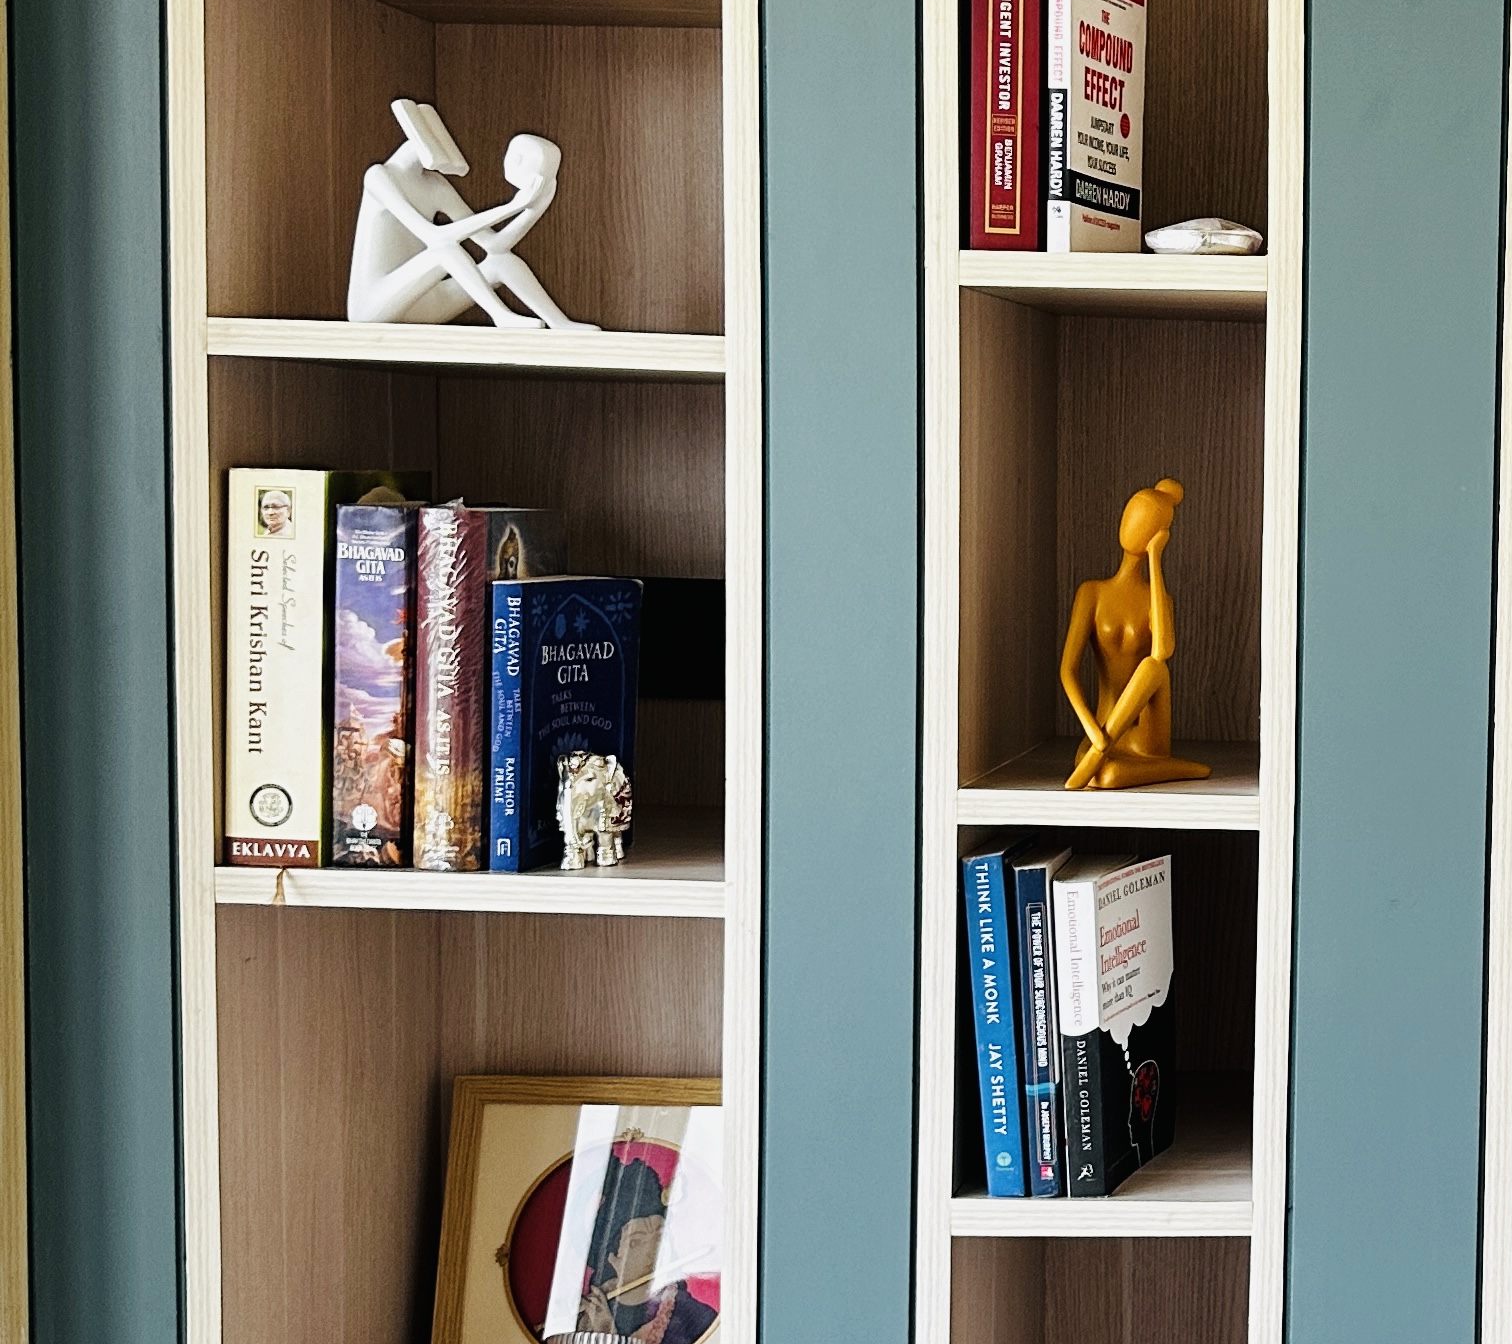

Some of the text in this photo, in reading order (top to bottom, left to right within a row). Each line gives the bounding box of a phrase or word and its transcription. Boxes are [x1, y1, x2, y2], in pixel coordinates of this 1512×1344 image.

[1053, 45, 1063, 83] EFFECT
[1079, 20, 1133, 74] COMPOUND
[998, 43, 1012, 111] INVESTOR
[1084, 66, 1125, 112] EFFECT
[1050, 92, 1064, 197] DARREN HARDY
[995, 142, 1003, 186] GRAHAM
[1076, 178, 1131, 211] DARREN HARDY
[337, 542, 405, 562] BHAGAVAD
[355, 560, 385, 575] GITA
[248, 549, 270, 754] Shri Krishan Kant
[493, 618, 508, 654] GITA
[507, 596, 522, 677] BHAGAVAD
[541, 641, 615, 665] BHAGAVAD
[437, 647, 454, 699] GITA
[557, 663, 589, 684] GITA
[436, 709, 452, 732] AS
[560, 702, 596, 714] BETWEEN
[572, 714, 590, 725] AND
[591, 716, 612, 731] GOD
[494, 767, 504, 804] PRIME
[504, 757, 516, 817] RANCHOR
[232, 841, 310, 859] EKLAVYA
[1099, 871, 1165, 911] DANIEL GOLEMAN
[1100, 909, 1140, 948] Emotional
[1066, 890, 1084, 1027] Emotional Intelligence
[1101, 939, 1147, 976] Intelligence
[975, 862, 1007, 1135] THINK LIKE A MONK JAY SHETTY
[1101, 980, 1112, 994] Why
[1125, 984, 1134, 998] IQ
[1076, 1040, 1092, 1151] DANIEL GOLEMAN
